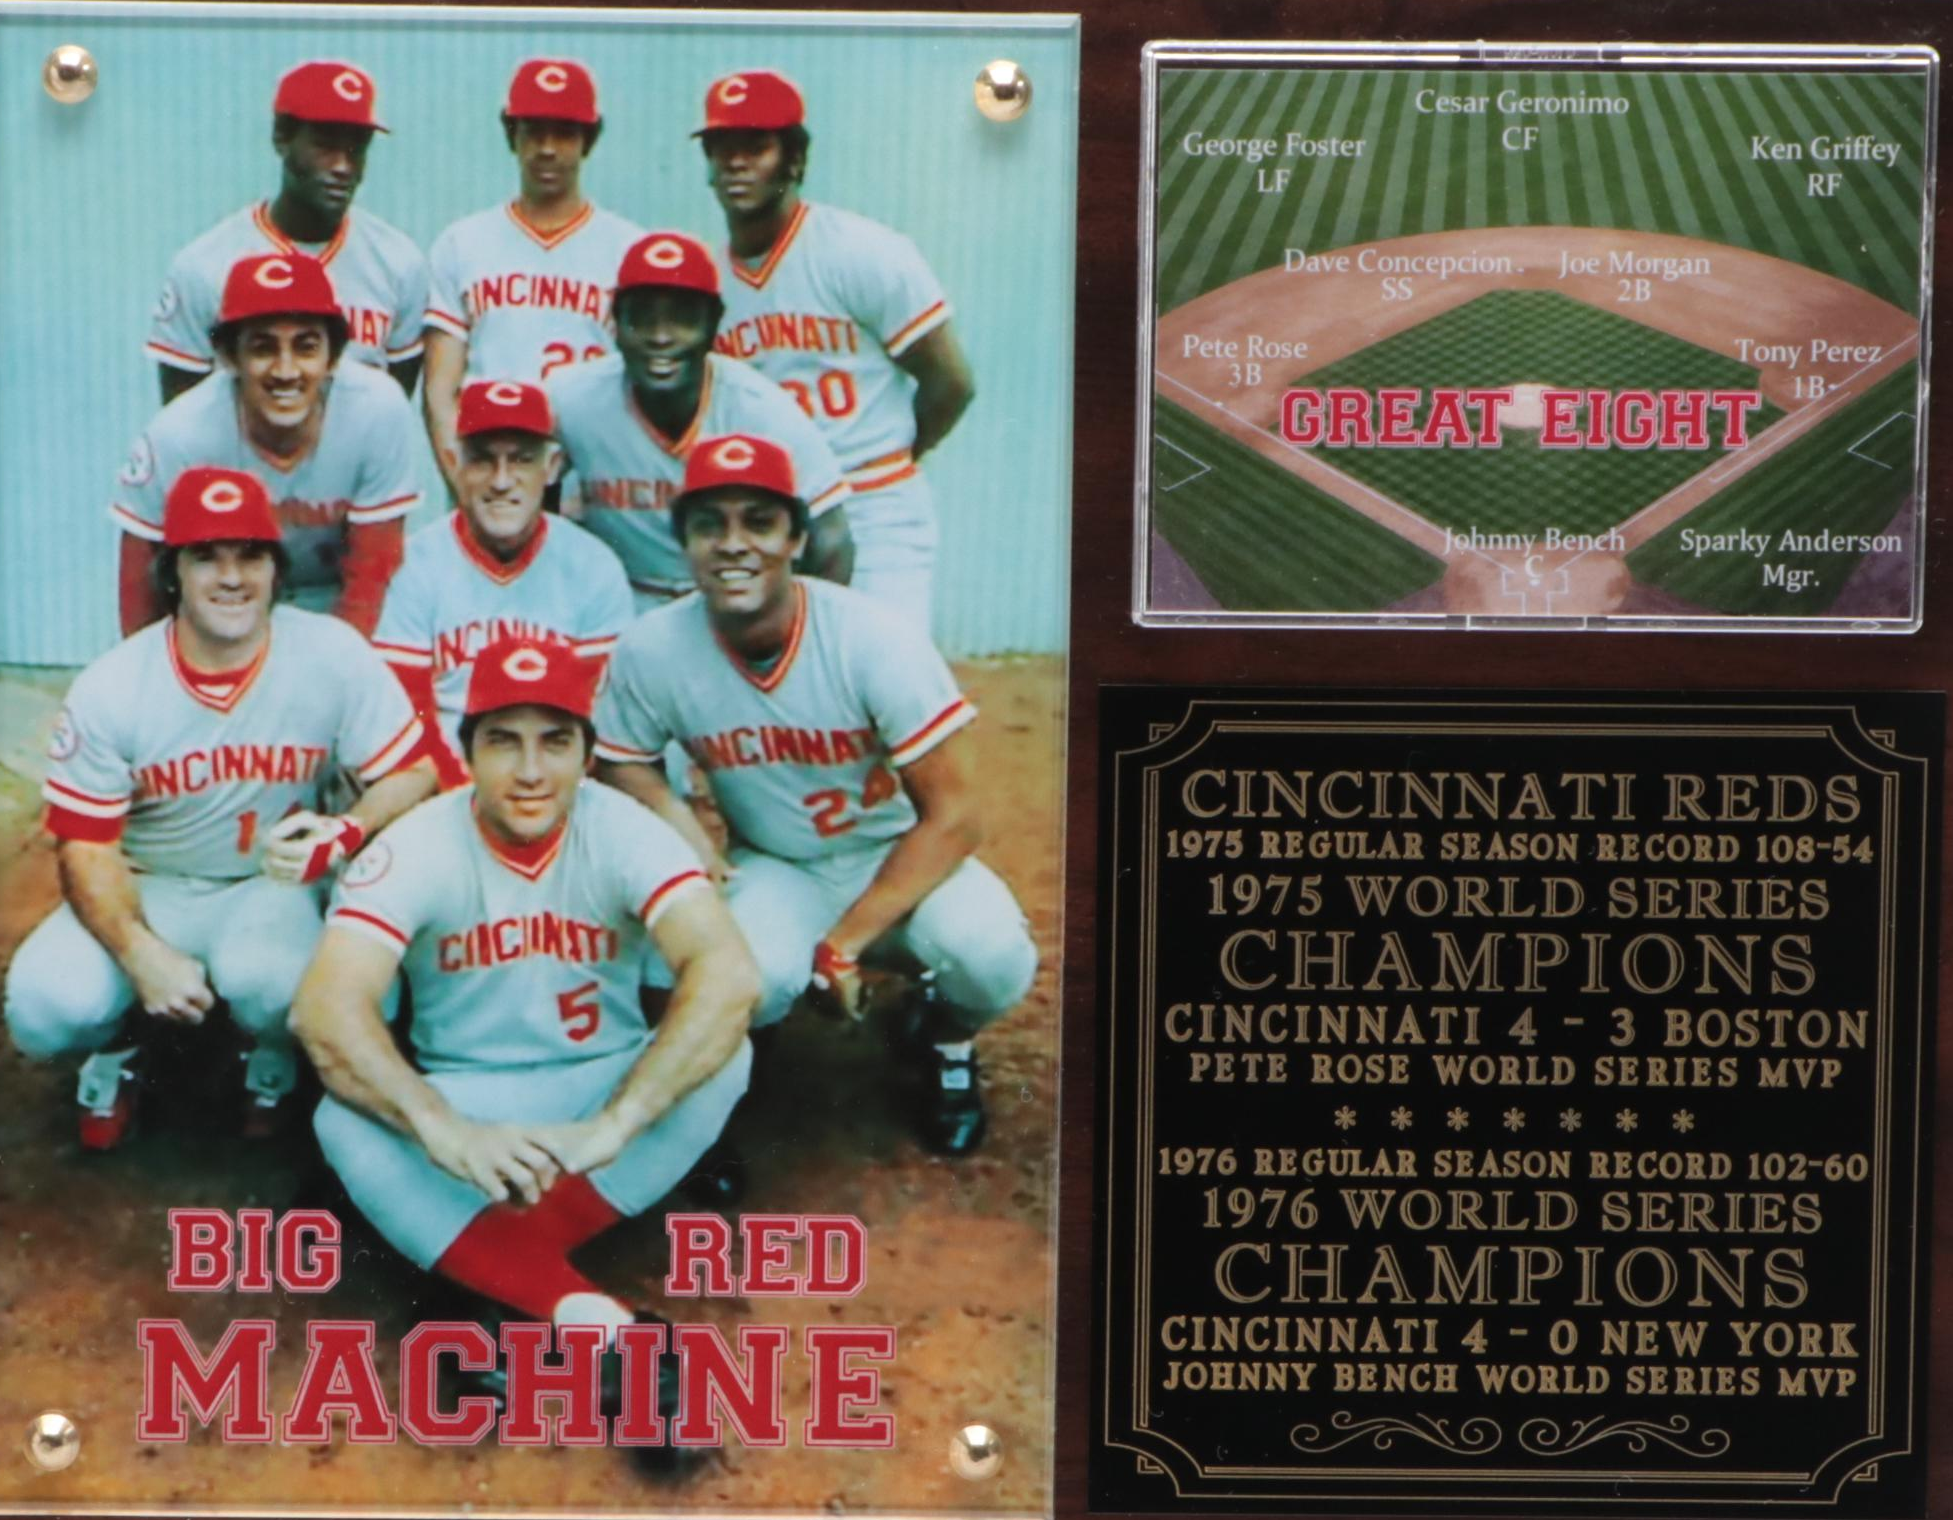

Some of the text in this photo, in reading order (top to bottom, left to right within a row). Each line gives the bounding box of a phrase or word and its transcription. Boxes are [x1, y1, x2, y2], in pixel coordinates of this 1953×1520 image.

[333, 71, 363, 101] C
[536, 65, 568, 92] C
[718, 76, 748, 105] C
[1416, 90, 1628, 113] Cesar Geronimo
[1183, 133, 1366, 162] George Foster
[1503, 127, 1537, 150] CF
[1753, 136, 1899, 166] Ken Griffey
[1259, 169, 1290, 192] LF
[1809, 174, 1841, 195] RF
[643, 239, 684, 269] C
[1284, 249, 1512, 279] Dave Concepcion
[1559, 251, 1711, 280] Joe Morgan
[254, 258, 294, 289] C
[1381, 278, 1413, 301] SS
[1617, 279, 1651, 301] 2B
[1182, 334, 1308, 358] Pete Rose
[1734, 338, 1882, 369] Tony Perez
[1228, 362, 1263, 388] 3B
[1794, 376, 1826, 399] 1B
[485, 381, 522, 406] C
[1280, 389, 1761, 449] GREAT EIGHT
[713, 439, 755, 470] C
[201, 480, 243, 512] C
[1443, 526, 1625, 557] Johnny Bench
[1680, 528, 1902, 558] Sparky Anderson
[1524, 555, 1544, 578] C
[1762, 564, 1820, 592] Mgr.
[502, 647, 548, 682] C
[1182, 769, 1861, 823] CINCINNATI REDS
[1167, 829, 1874, 864] 1975 REGULAR SEASON RECORD 108-54
[1208, 873, 1830, 920] 1975 WORLD SERIES
[1220, 929, 1815, 996] CHAMPIONS
[557, 981, 600, 1042] 5
[1164, 1002, 1480, 1045] CINCINNATI
[1508, 1007, 1537, 1045] 4
[1610, 1007, 1636, 1047] 3
[1663, 1008, 1869, 1049] BOSTON
[1189, 1052, 1842, 1089] PETE ROSE WORLD SERIES MVP
[1159, 1147, 1869, 1182] 1976 REGULAR SEASON RECORD 102-60
[1203, 1187, 1822, 1234] 1976 WORLD SERIES
[168, 1208, 867, 1297] BIG RED
[1214, 1242, 1808, 1309] CHAMPIONS
[1161, 1314, 1439, 1354] CINCINNATI
[1461, 1318, 1488, 1354] 4
[1549, 1319, 1578, 1356] 0
[1600, 1320, 1708, 1357] NEW
[1729, 1321, 1859, 1358] YORK
[137, 1318, 896, 1449] MACHINE
[1162, 1361, 1857, 1397] JOHNNY BENCH WORLD SERIES MVP
